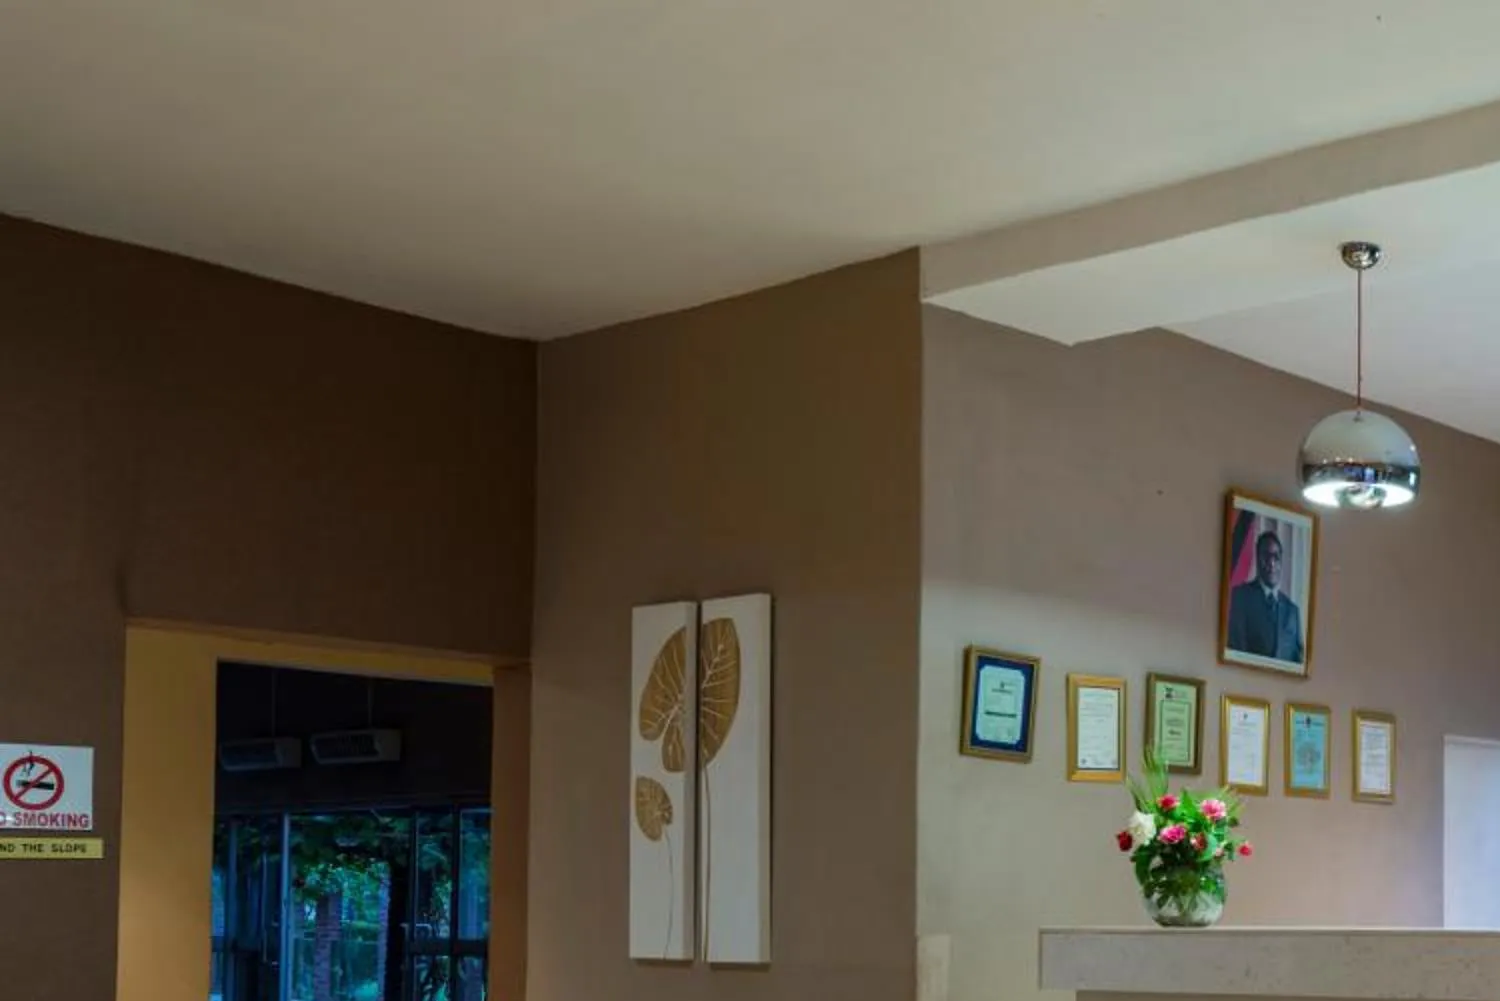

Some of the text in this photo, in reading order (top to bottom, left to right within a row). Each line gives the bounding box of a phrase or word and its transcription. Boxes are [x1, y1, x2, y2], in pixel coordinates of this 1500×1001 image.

[14, 812, 89, 828] SMOKING
[21, 843, 44, 853] THE
[51, 843, 87, 853] SLOPE
